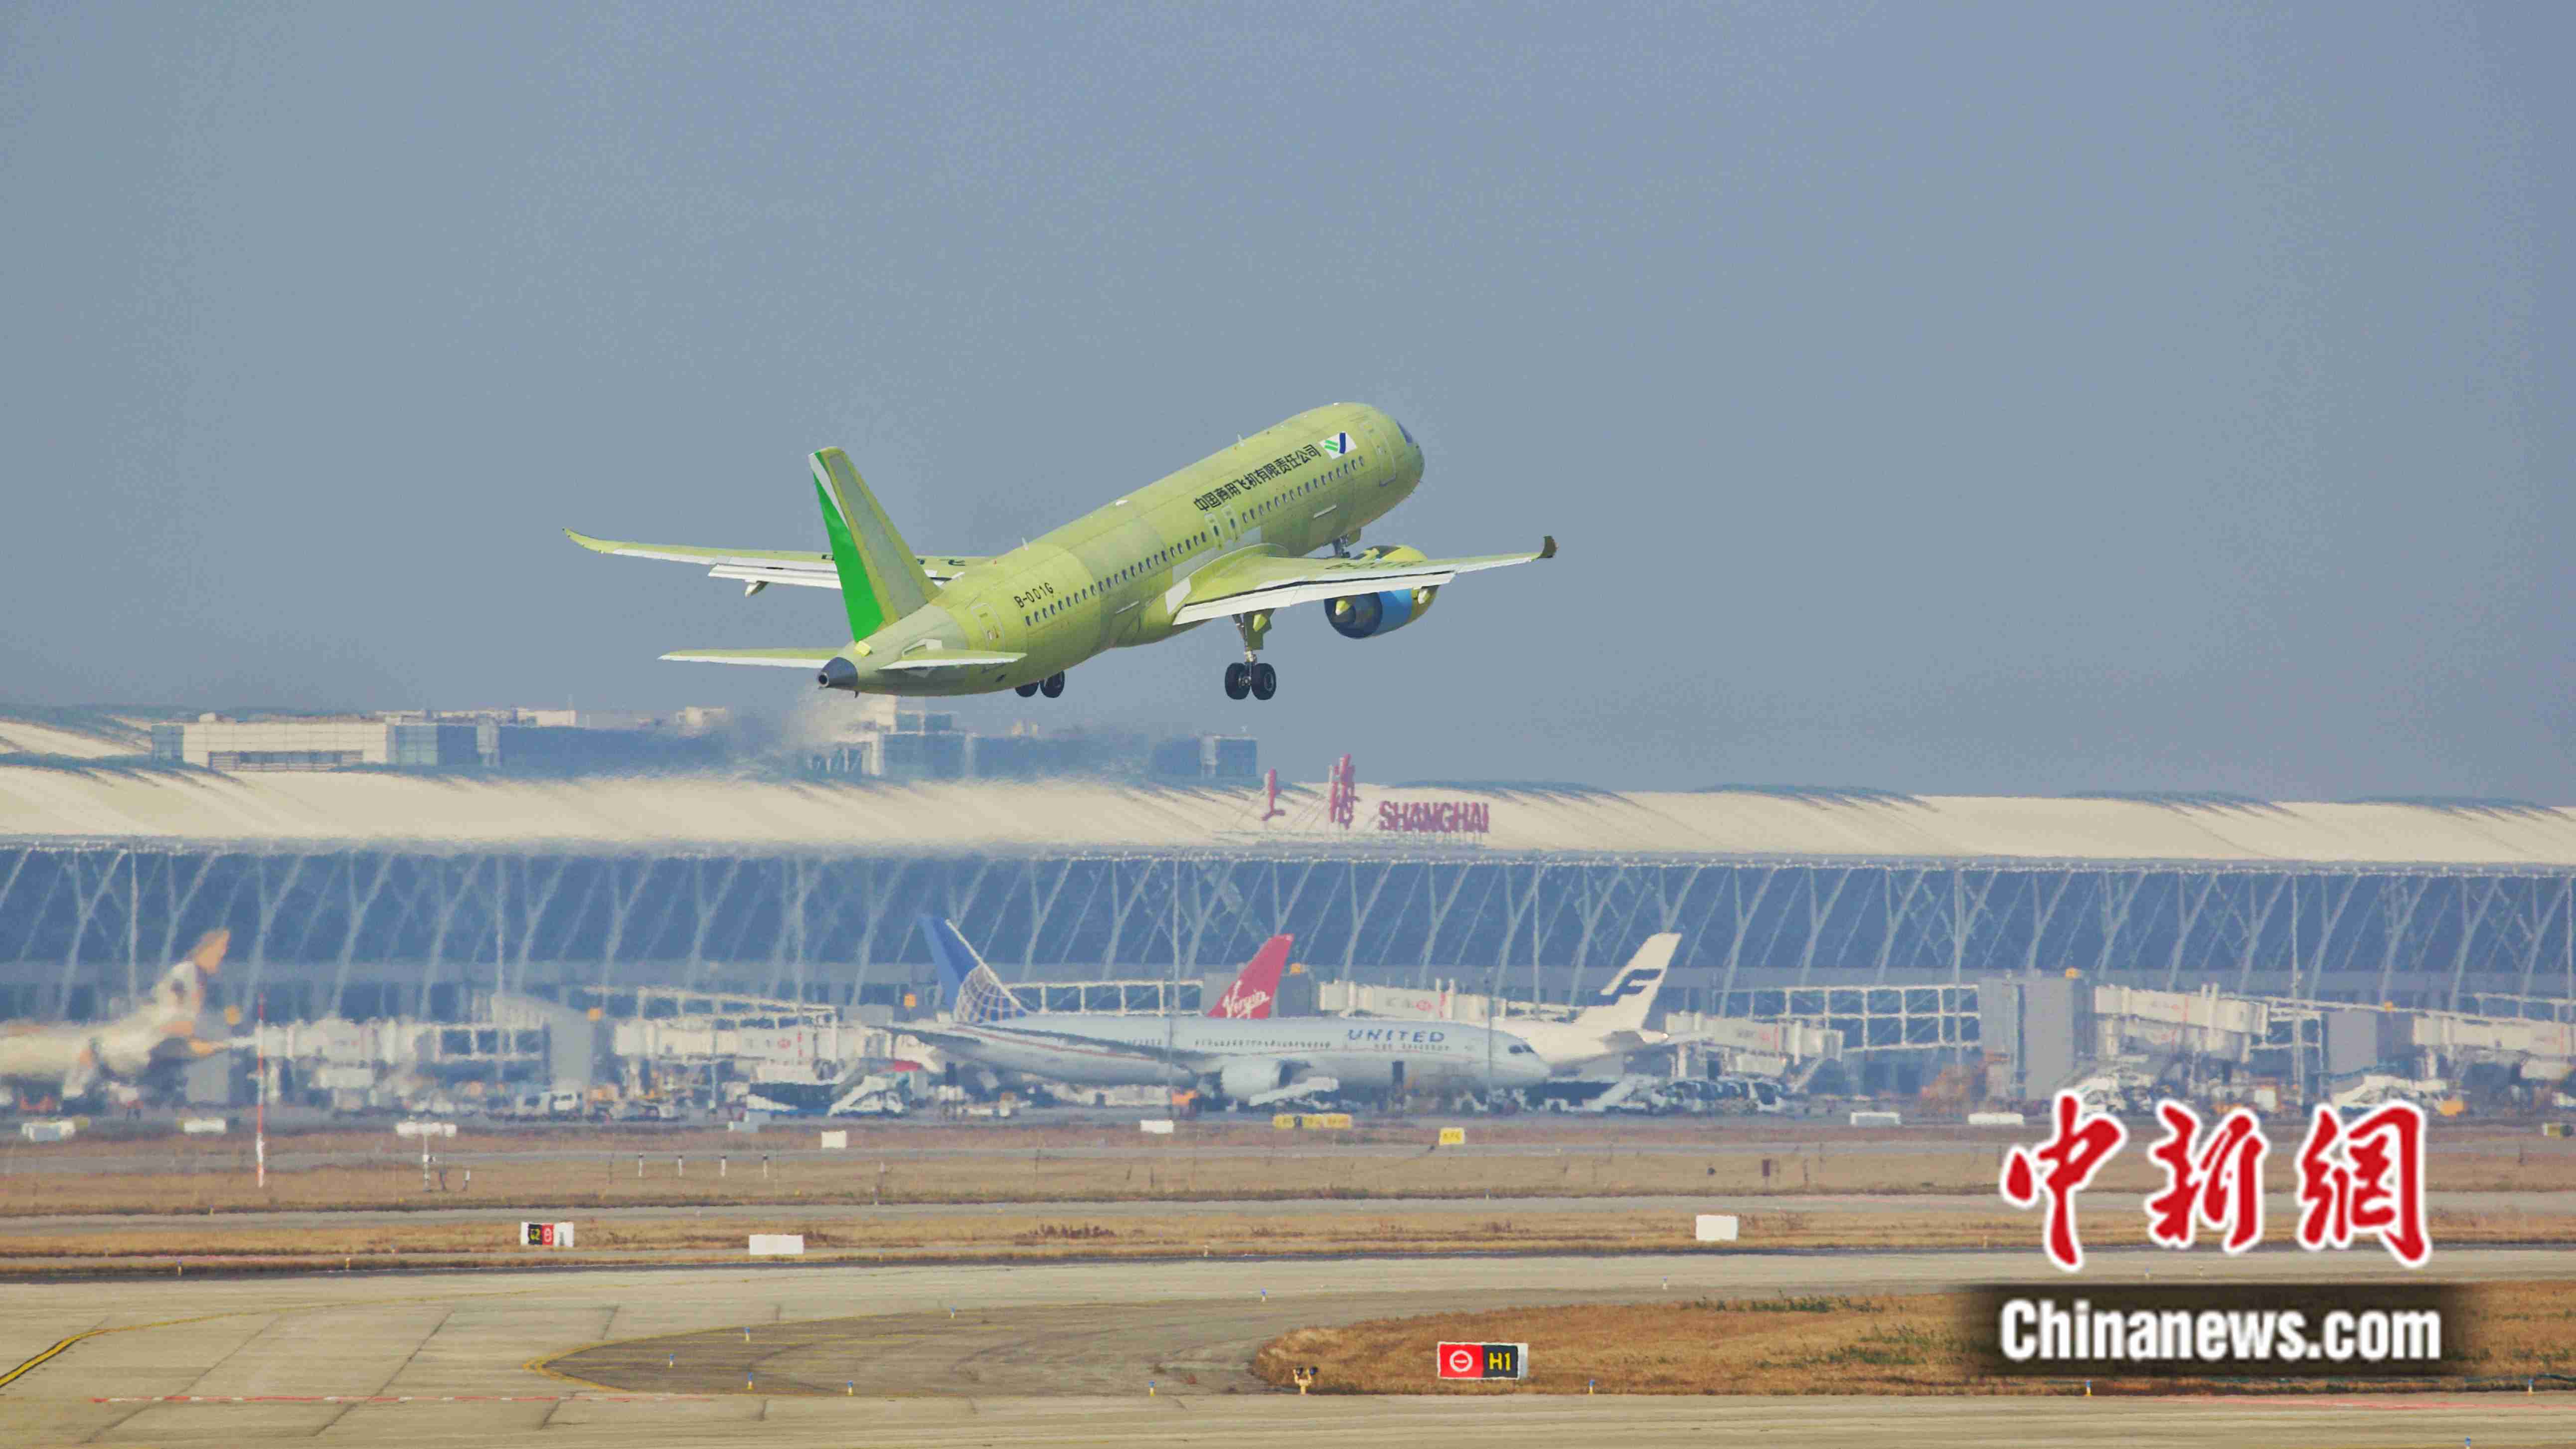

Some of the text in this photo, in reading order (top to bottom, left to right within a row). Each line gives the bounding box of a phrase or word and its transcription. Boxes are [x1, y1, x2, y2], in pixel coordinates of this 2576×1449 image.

[1193, 444, 1321, 511] 中国商用飞机有限责任公司
[1378, 800, 1489, 833] SHANGHAI
[1223, 980, 1270, 1019] Virgin
[1347, 1028, 1445, 1043] UNITED
[1489, 1352, 1511, 1371] H1
